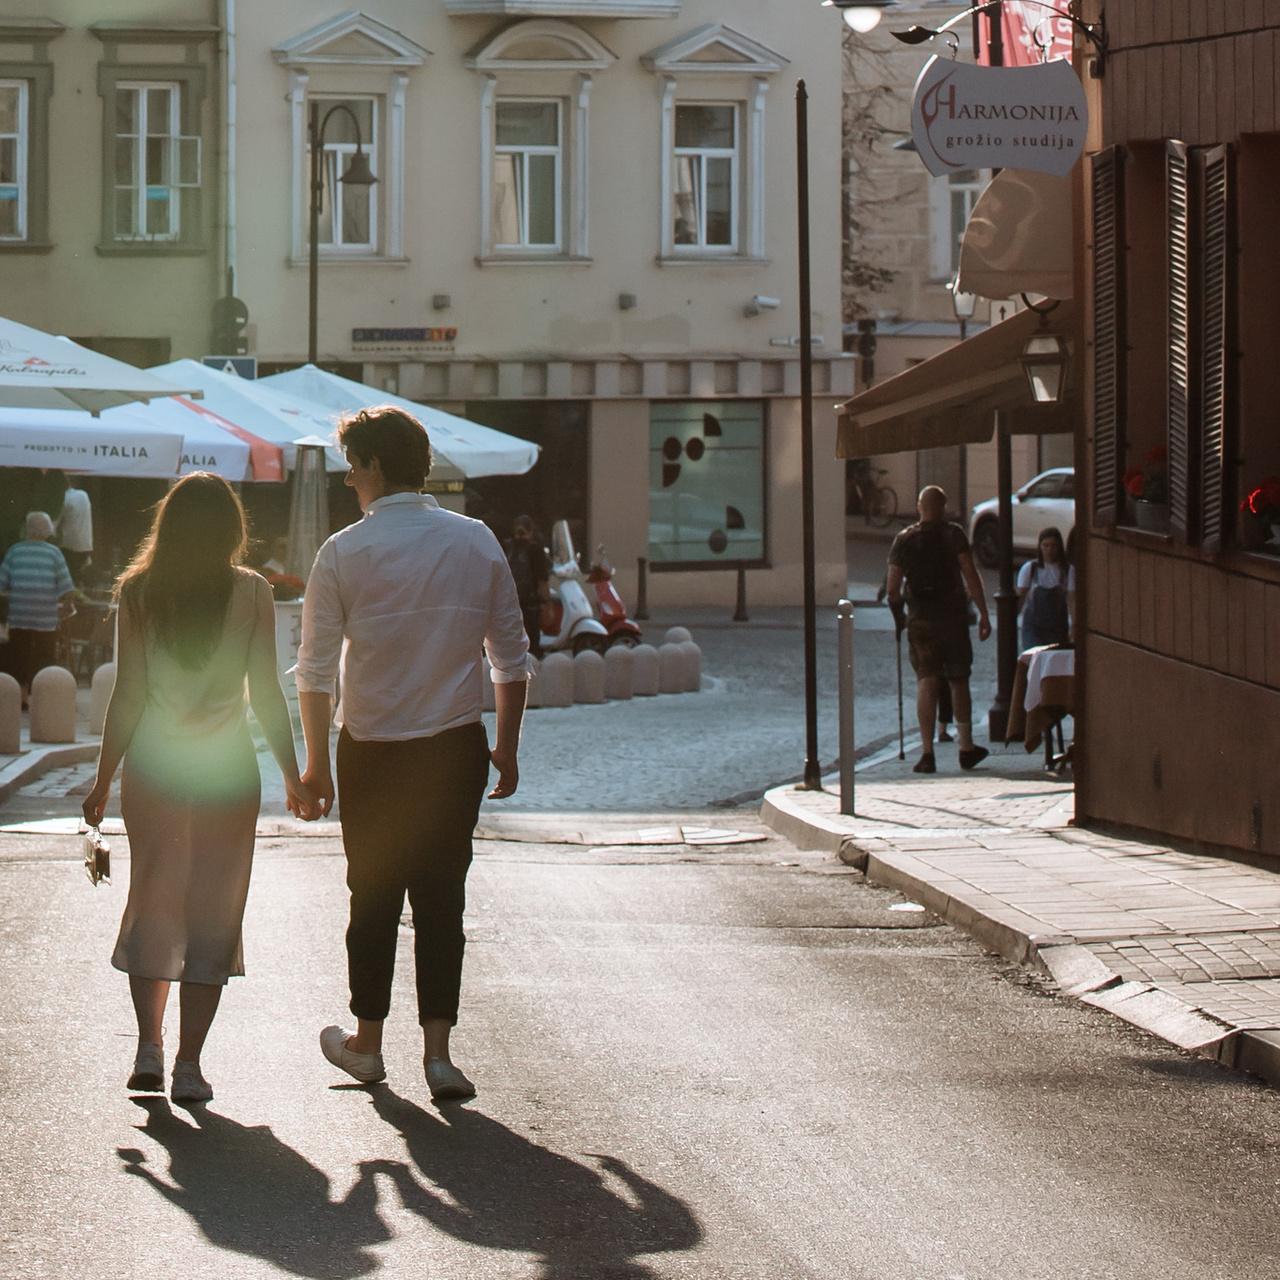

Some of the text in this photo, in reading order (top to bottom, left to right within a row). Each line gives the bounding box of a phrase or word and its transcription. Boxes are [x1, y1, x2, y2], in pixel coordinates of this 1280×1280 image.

[921, 81, 1079, 125] HARMONIJA
[945, 133, 1075, 150] grožio studija
[93, 444, 149, 458] ITALIA
